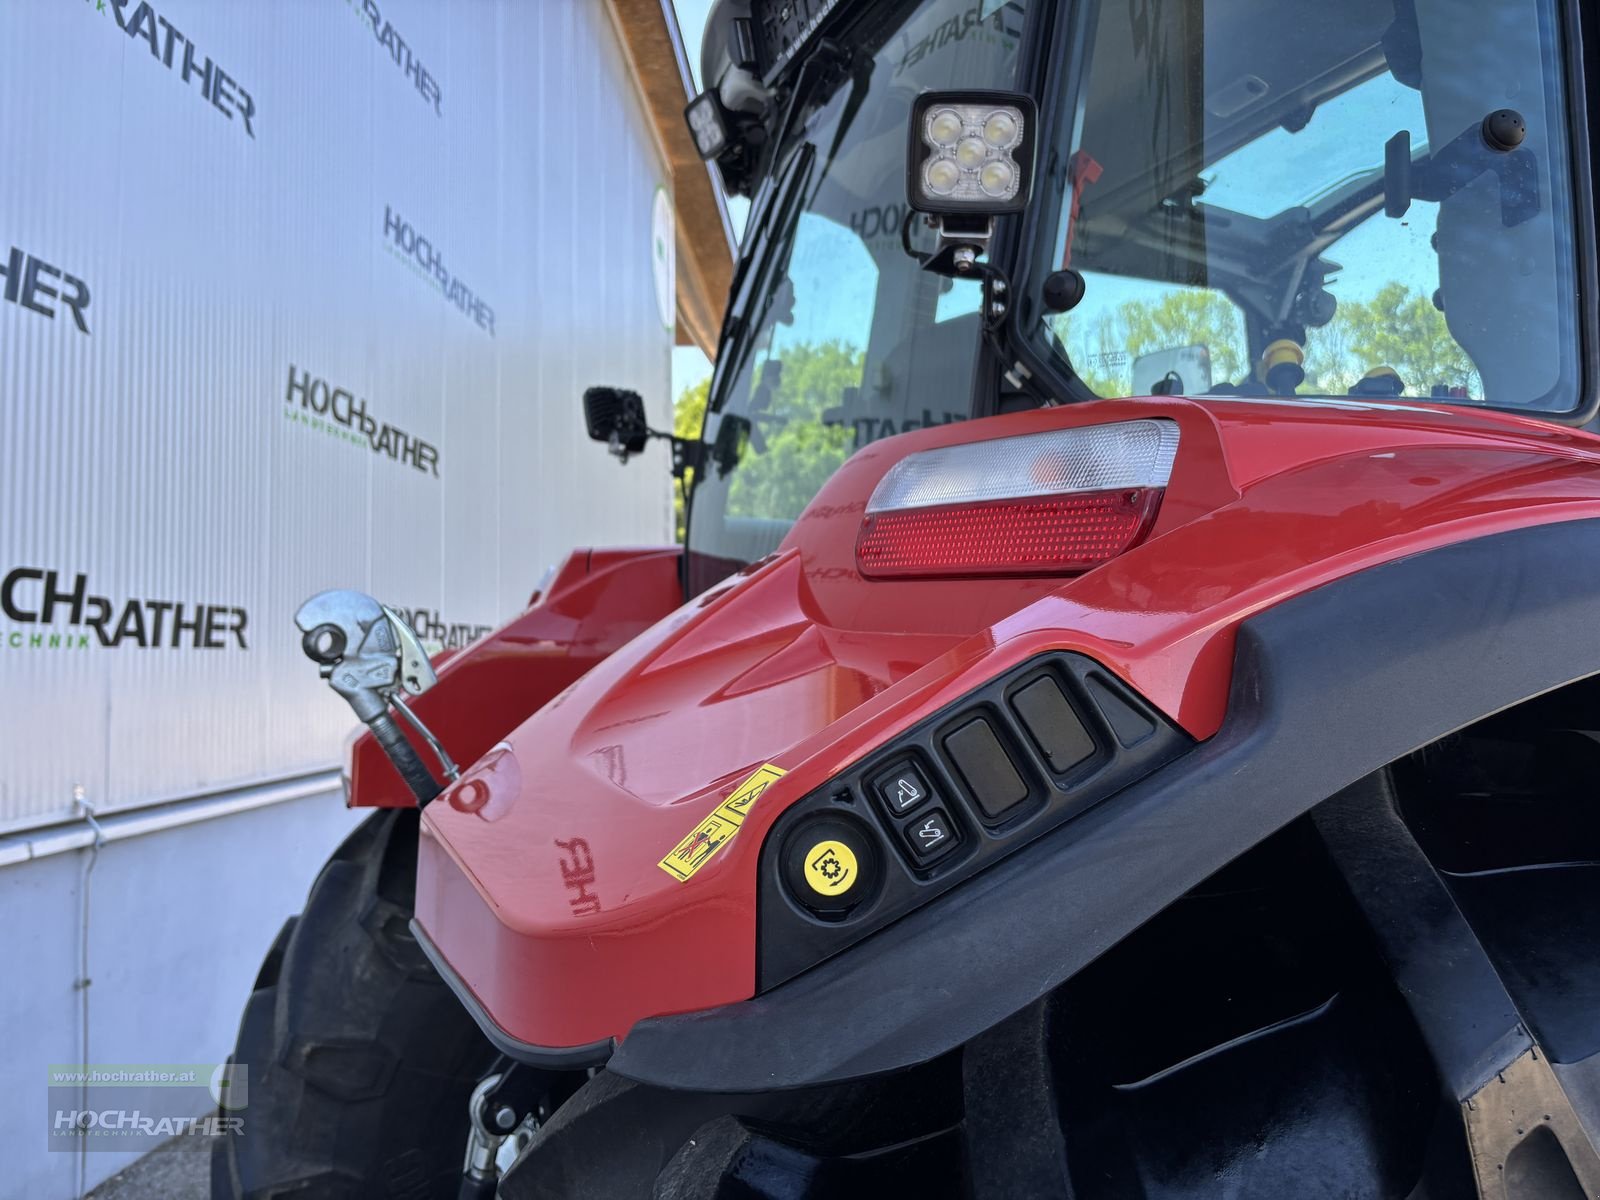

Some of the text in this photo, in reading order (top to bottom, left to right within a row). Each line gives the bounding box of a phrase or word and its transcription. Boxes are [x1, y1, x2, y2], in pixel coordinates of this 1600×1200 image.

[384, 203, 495, 338] HOCHRATHER
[286, 363, 440, 479] HOCHRATHER
[0, 567, 249, 649] CHRATHER
[0, 631, 90, 648] CHNIK
